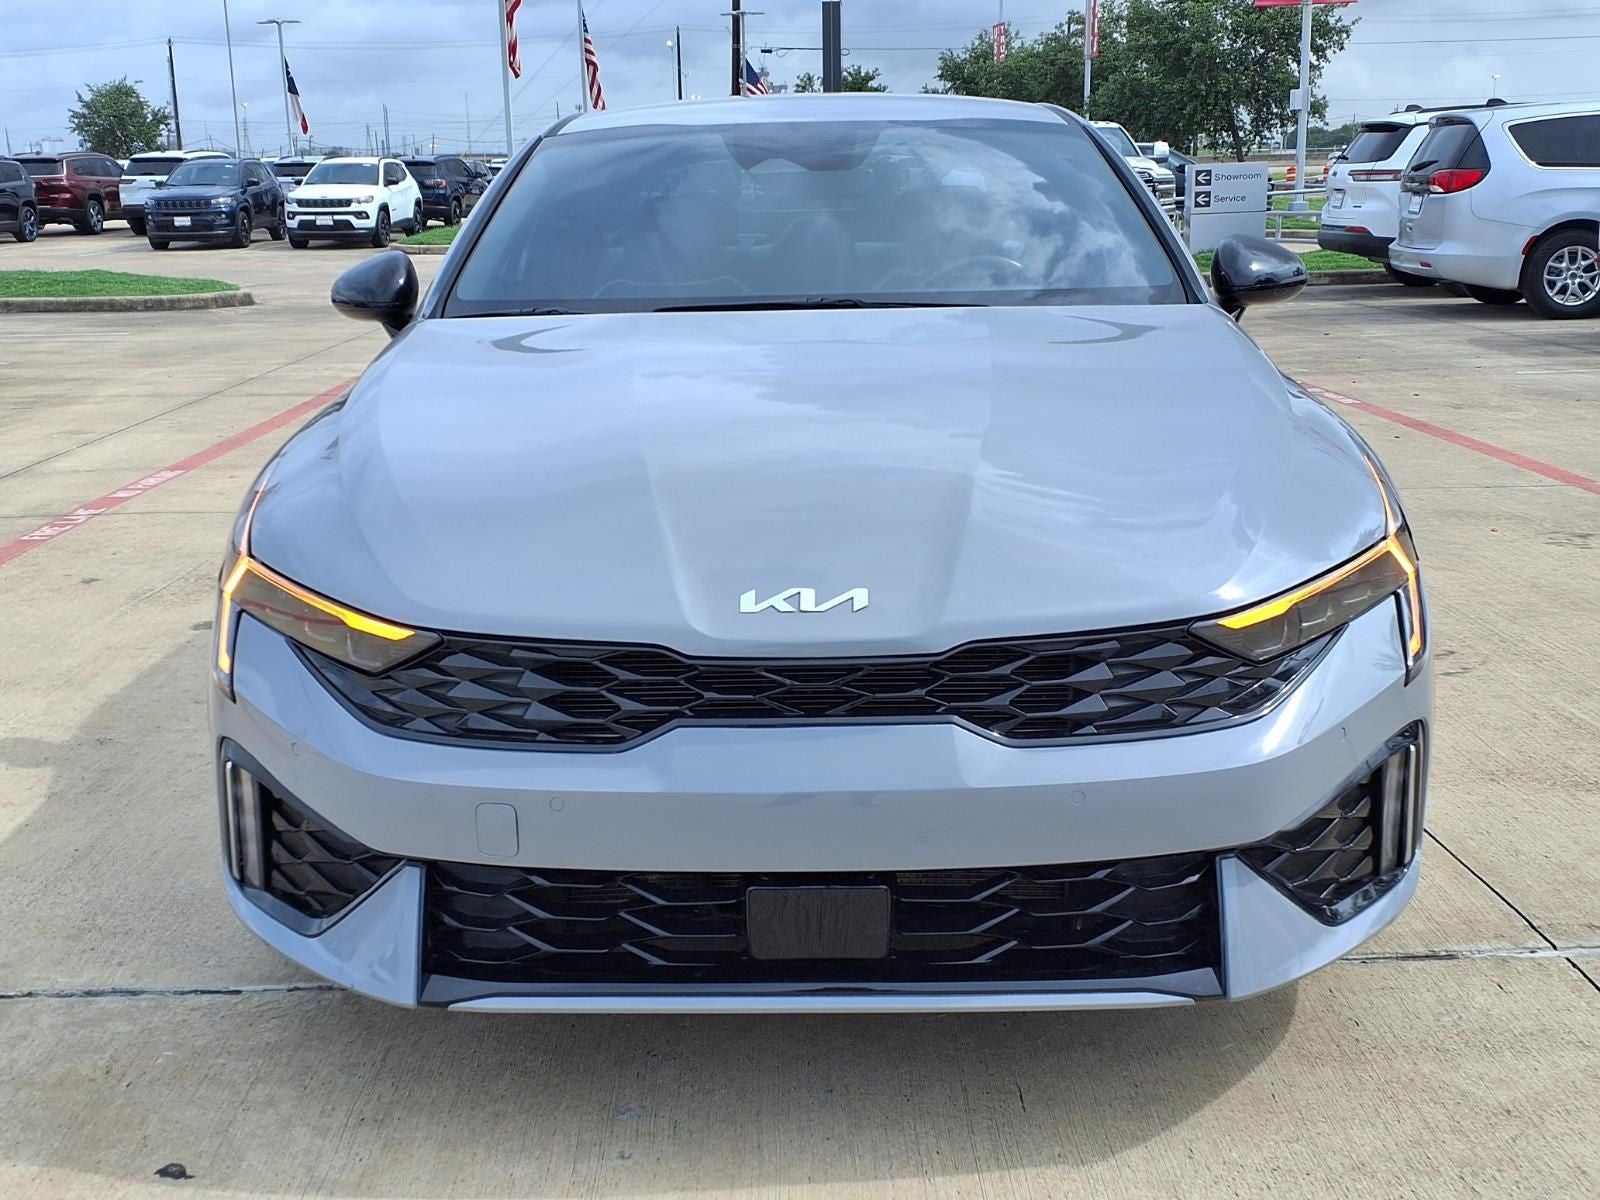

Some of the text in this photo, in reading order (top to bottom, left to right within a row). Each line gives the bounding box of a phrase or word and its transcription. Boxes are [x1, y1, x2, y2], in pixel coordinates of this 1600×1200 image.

[1214, 173, 1262, 181] Showroom
[1213, 194, 1247, 203] Service
[740, 587, 869, 613] KIA
